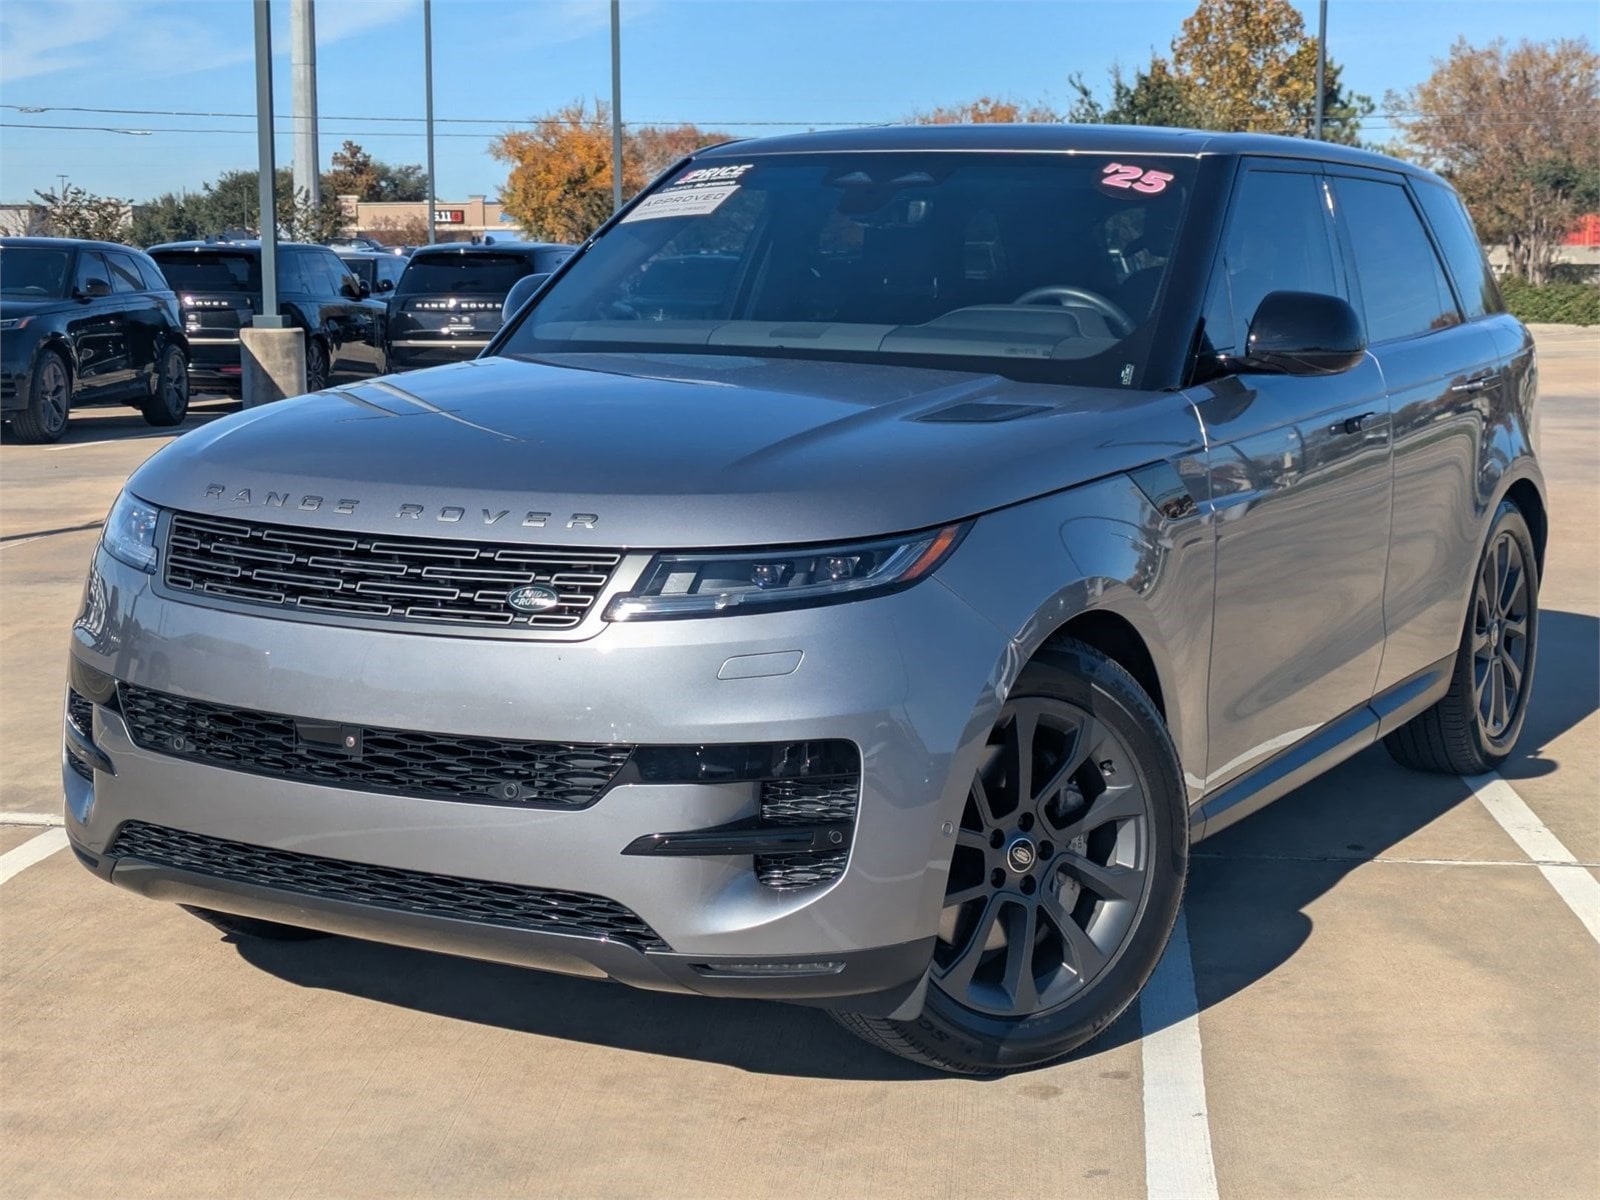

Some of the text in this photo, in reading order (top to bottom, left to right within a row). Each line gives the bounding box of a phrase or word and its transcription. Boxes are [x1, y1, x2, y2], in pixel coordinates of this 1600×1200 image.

[1101, 162, 1175, 193] '25
[643, 192, 725, 208] APPROVED
[203, 483, 599, 529] RANGE ROVER
[517, 590, 543, 598] LAND
[518, 597, 549, 606] ROV
